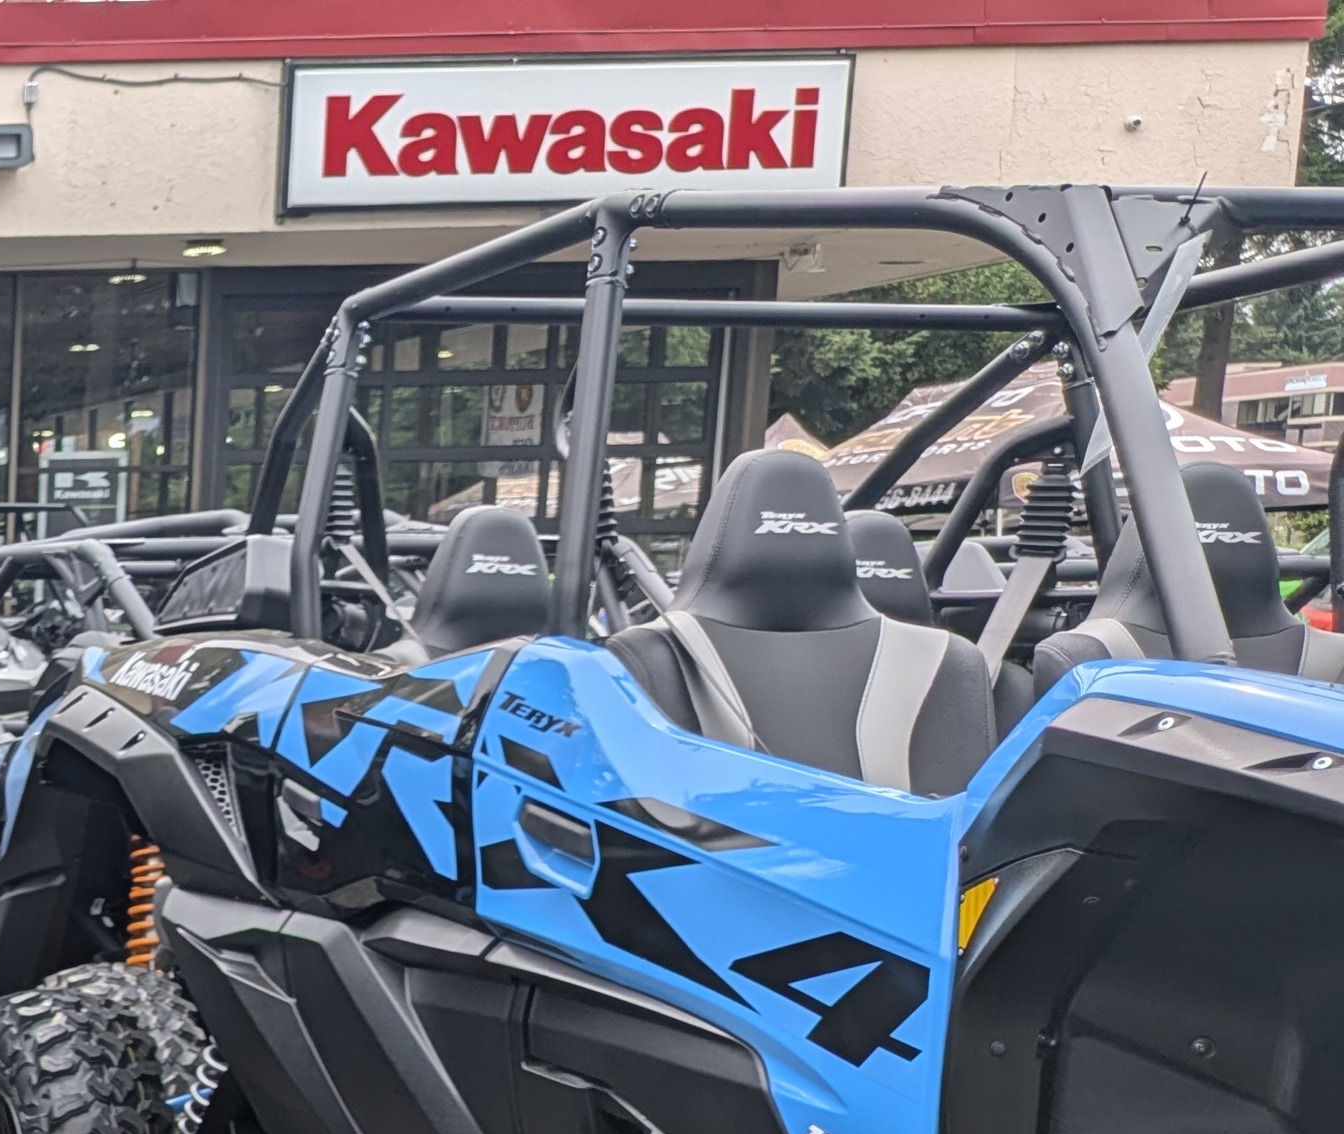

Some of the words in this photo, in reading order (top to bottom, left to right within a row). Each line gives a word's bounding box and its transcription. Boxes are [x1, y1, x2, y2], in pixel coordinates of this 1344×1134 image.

[321, 86, 821, 178] Kawasaki
[753, 520, 840, 535] KRX
[465, 562, 538, 575] KRX
[109, 650, 201, 701] Kawasaki
